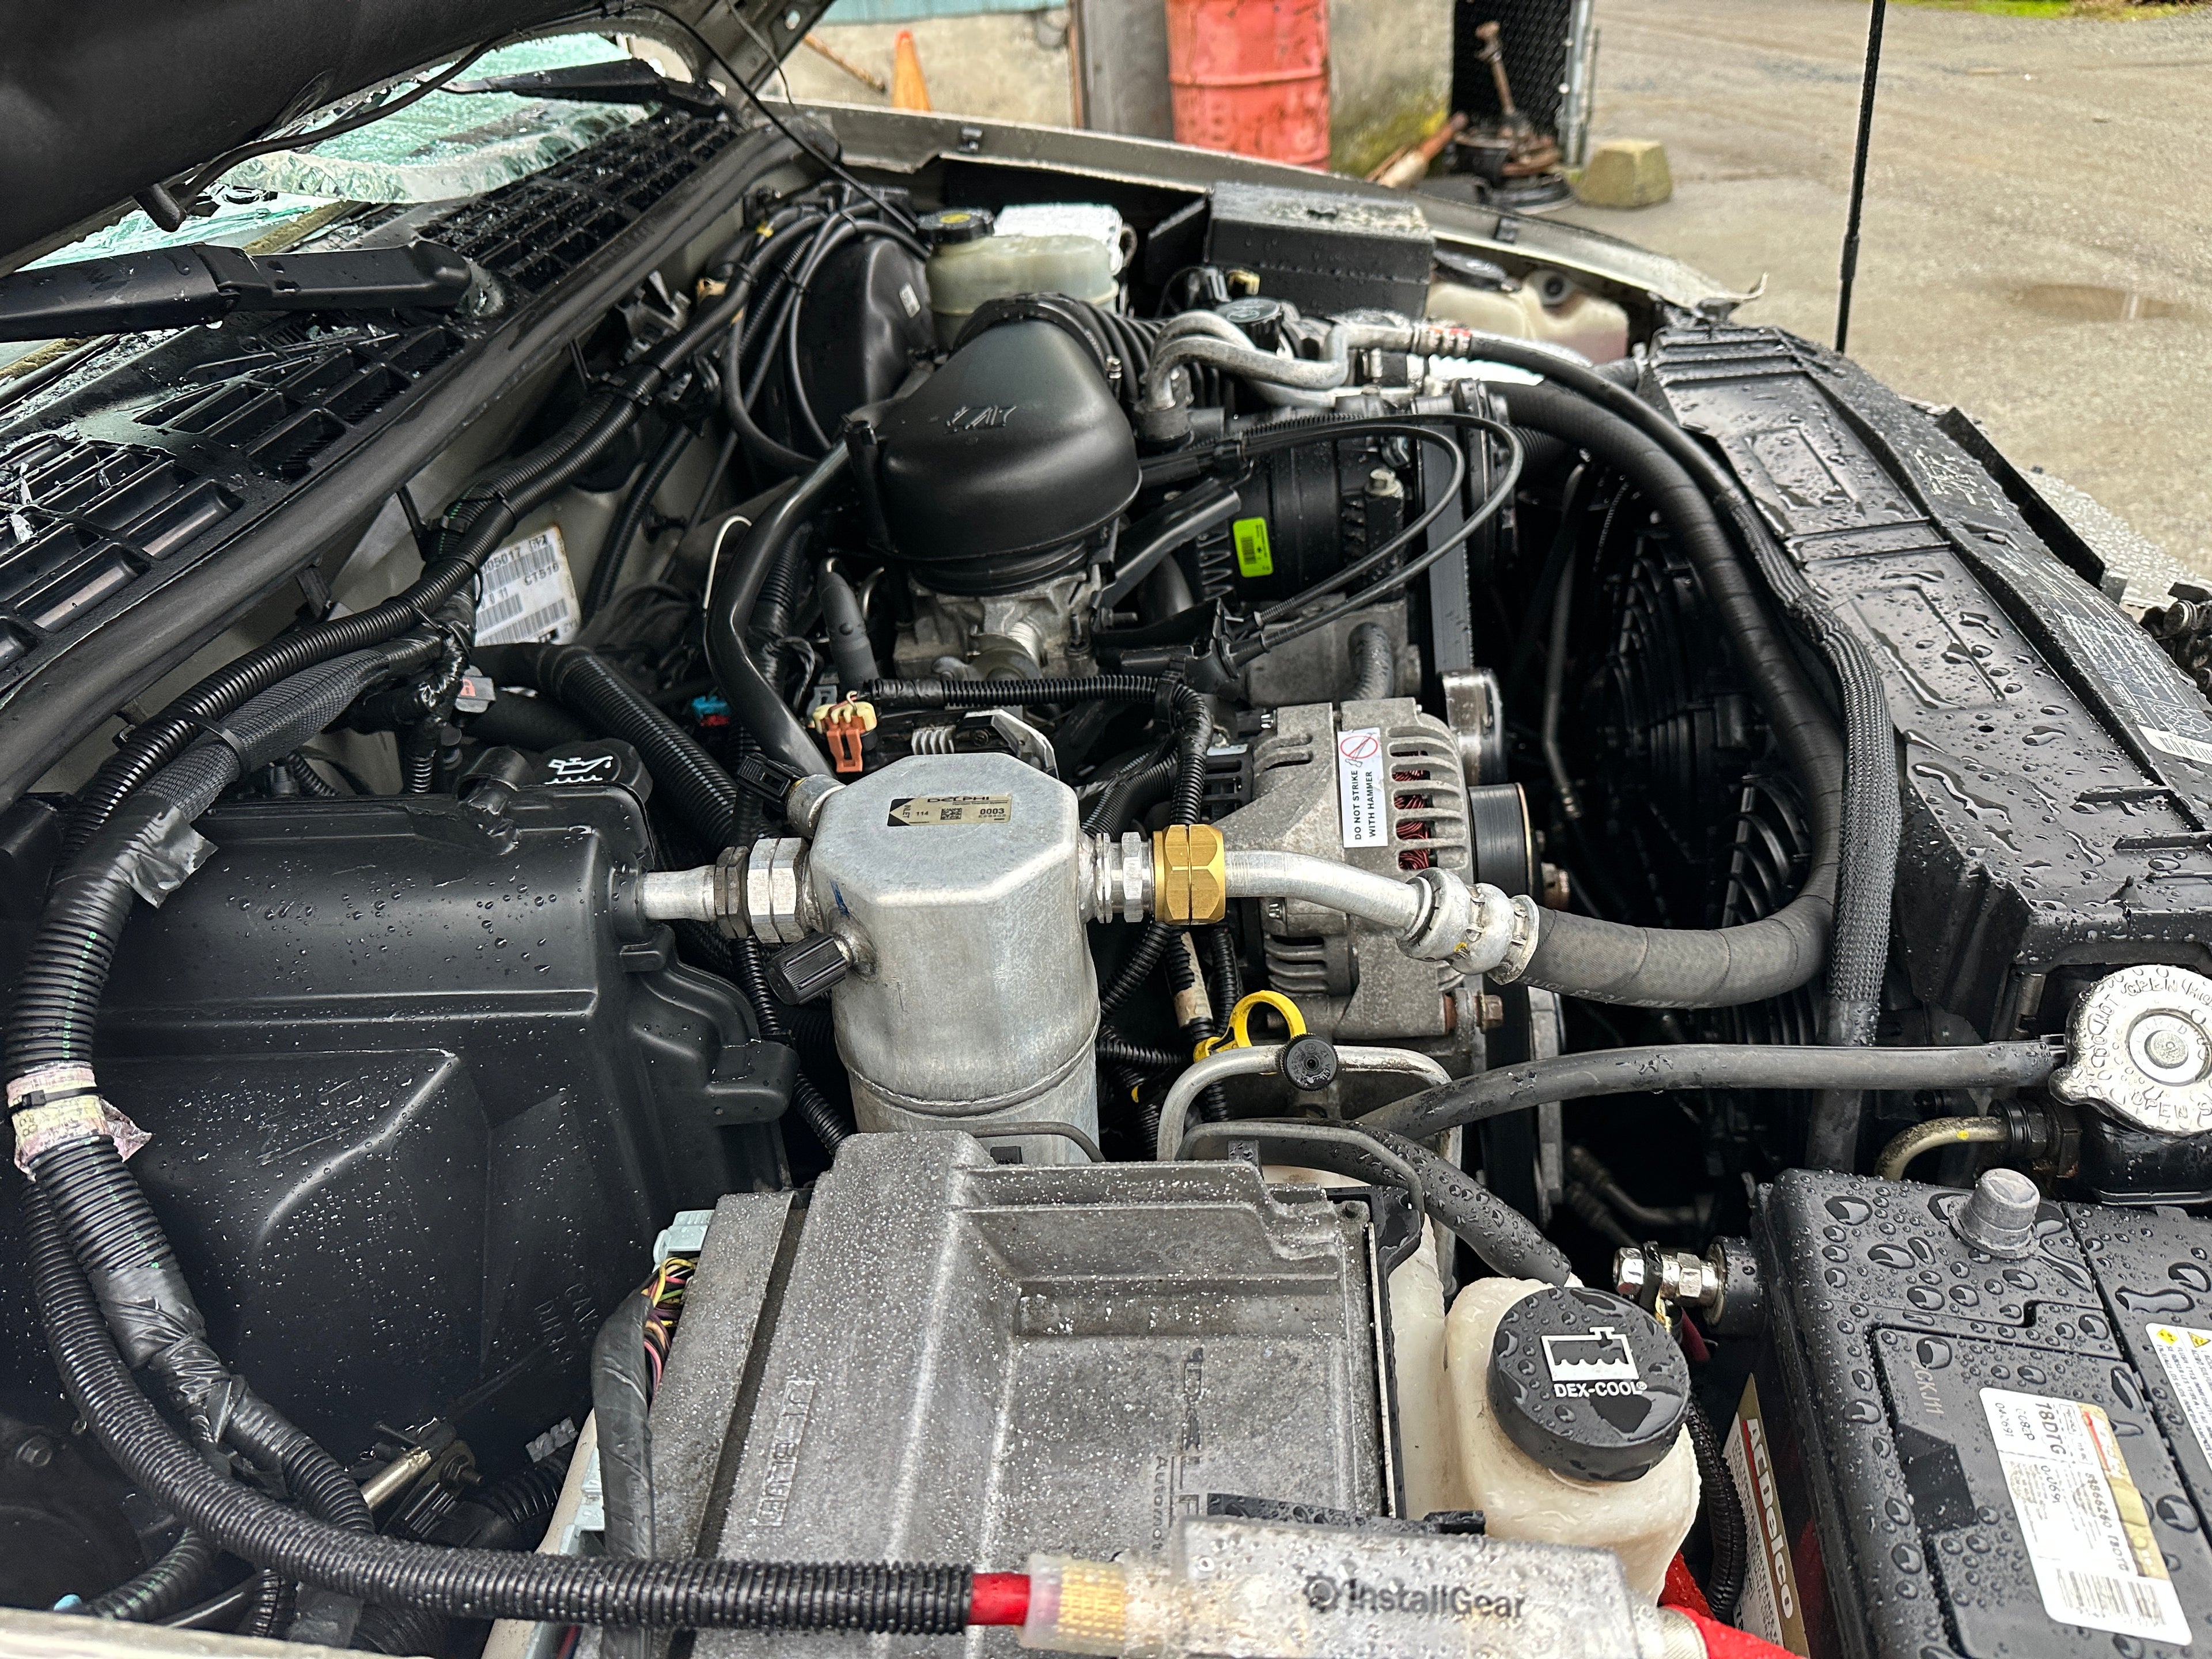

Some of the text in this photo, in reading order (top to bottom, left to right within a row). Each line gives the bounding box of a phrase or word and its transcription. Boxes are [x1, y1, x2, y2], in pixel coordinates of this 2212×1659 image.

[1351, 770, 1359, 801] STRIKE
[1365, 771, 1376, 838] WITH HAMMER
[1355, 826, 1362, 840] DO
[1745, 1418, 1793, 1619] ACDelco
[1347, 1578, 1526, 1619] InstallGear
